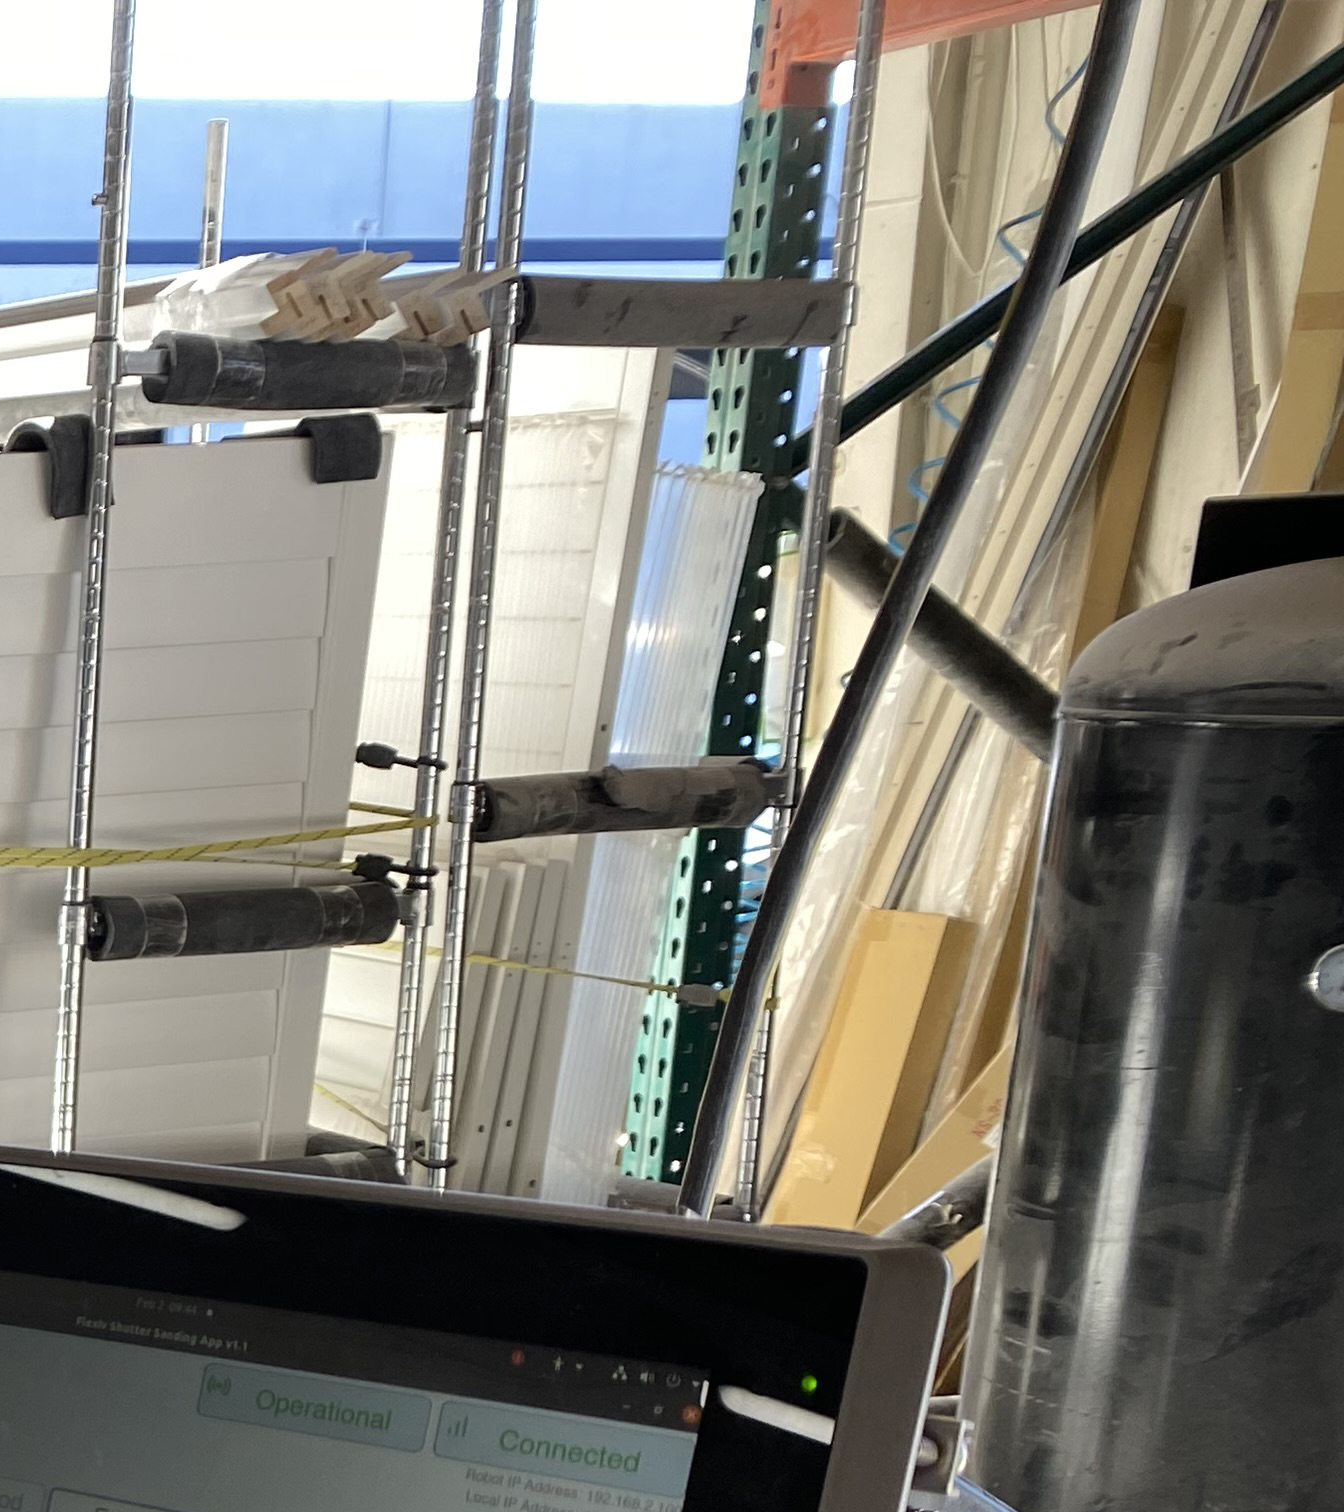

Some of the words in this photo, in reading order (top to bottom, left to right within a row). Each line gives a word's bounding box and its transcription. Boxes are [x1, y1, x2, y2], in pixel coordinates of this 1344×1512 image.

[110, 1320, 153, 1338] Shutter
[154, 1328, 197, 1347] Sanding
[199, 1335, 223, 1350] App
[254, 1388, 392, 1432] Operational
[498, 1429, 641, 1475] Connected
[465, 1467, 504, 1487] Robot
[507, 1474, 522, 1488] IP
[465, 1489, 500, 1507] Local
[503, 1496, 518, 1508] IP
